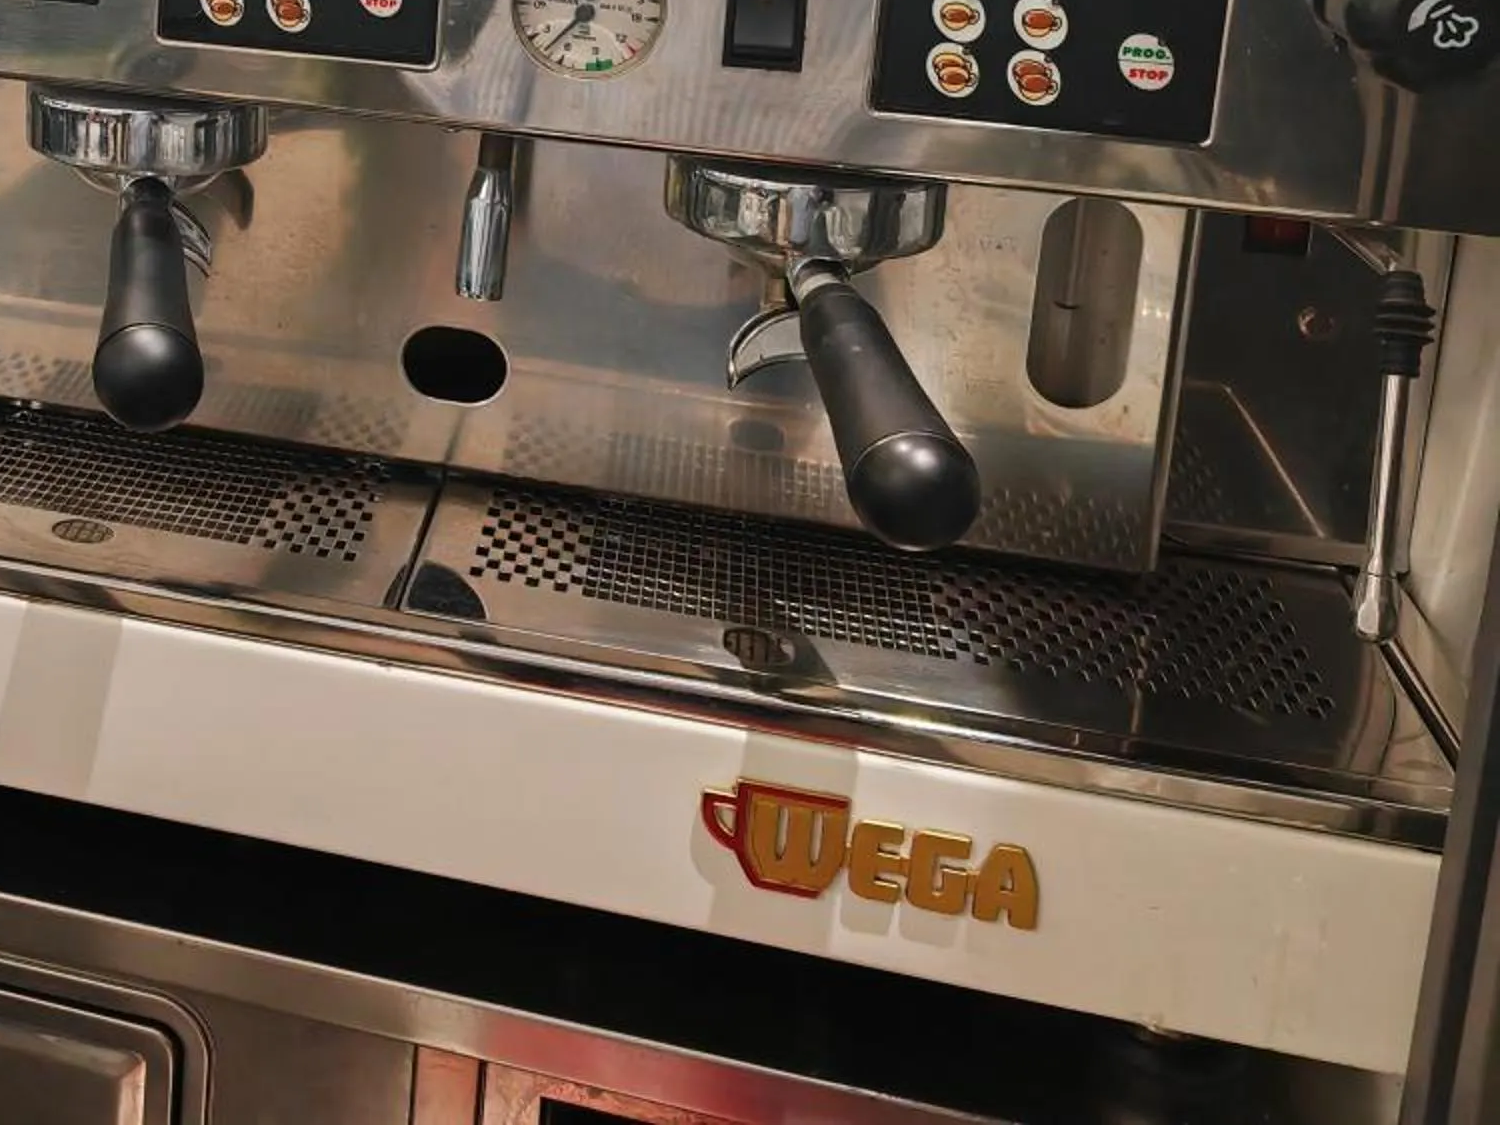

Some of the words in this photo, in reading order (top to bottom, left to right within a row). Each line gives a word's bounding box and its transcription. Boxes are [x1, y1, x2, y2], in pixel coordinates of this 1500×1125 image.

[1123, 46, 1171, 60] PROG.
[1129, 68, 1169, 80] STOP
[750, 796, 1039, 931] WEGA
